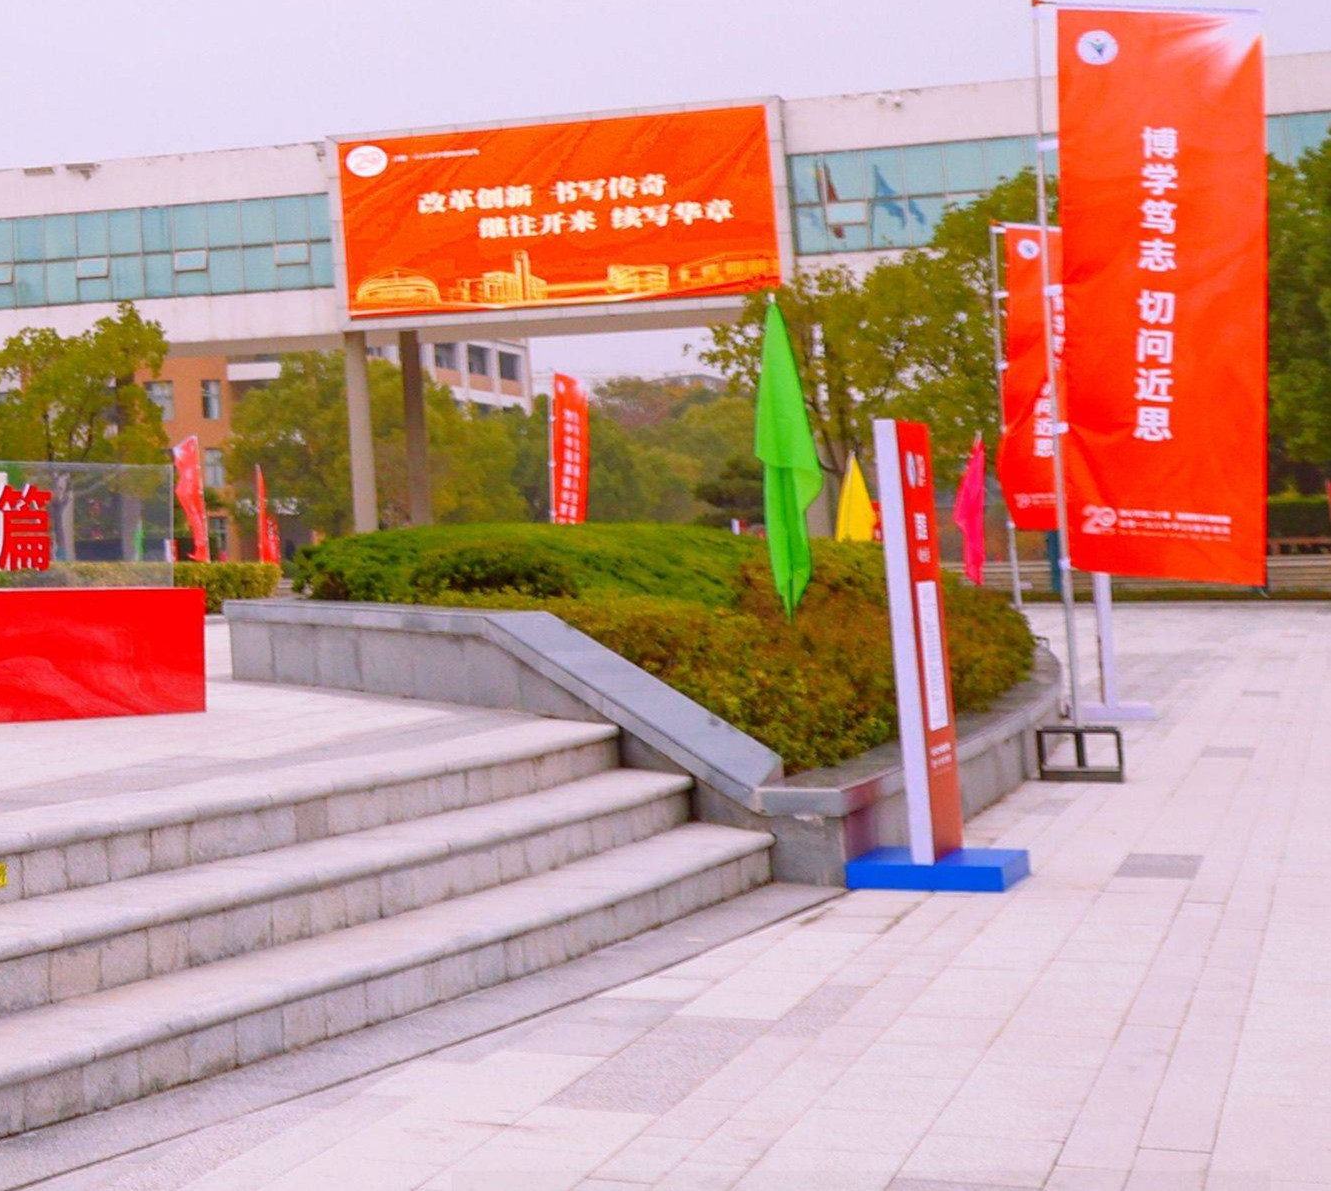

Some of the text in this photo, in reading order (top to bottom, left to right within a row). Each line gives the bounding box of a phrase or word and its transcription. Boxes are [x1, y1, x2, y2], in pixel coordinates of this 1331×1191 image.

[417, 173, 668, 214] 改革创新 书写传奇
[1133, 126, 1179, 443] 博学笃志 切问近思
